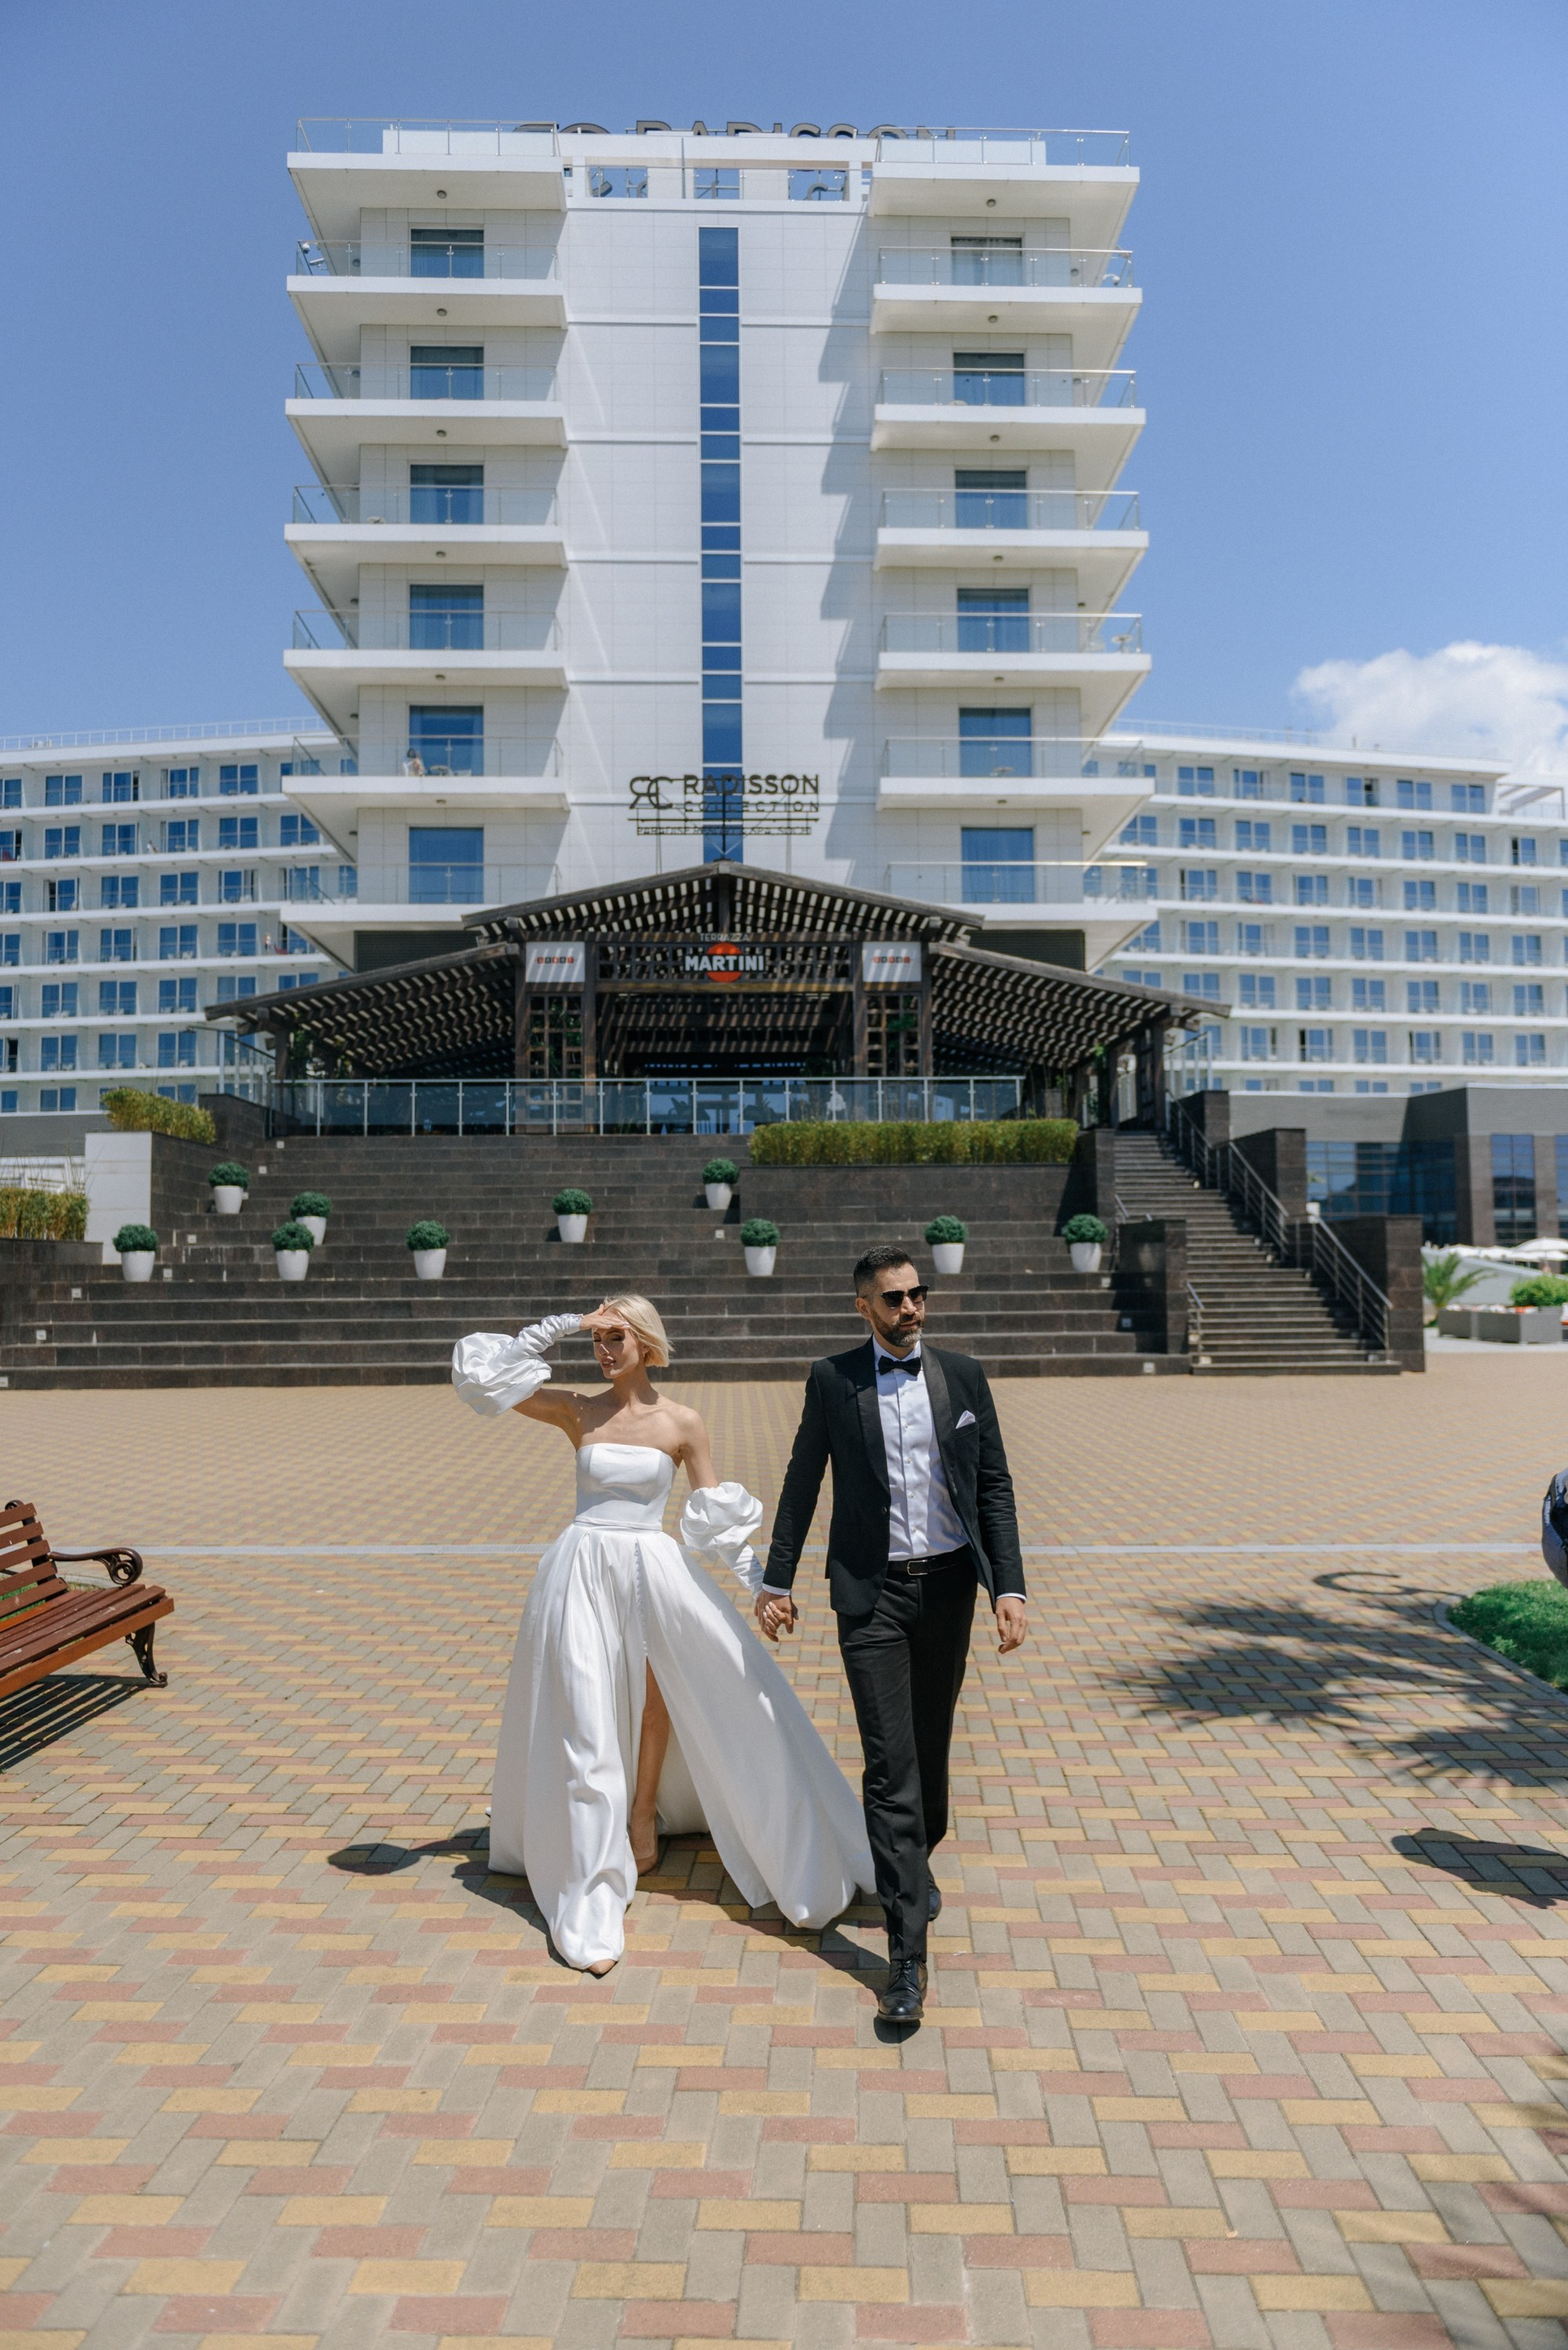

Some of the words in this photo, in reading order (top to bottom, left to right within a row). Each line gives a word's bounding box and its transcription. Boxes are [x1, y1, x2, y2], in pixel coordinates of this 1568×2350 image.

[684, 774, 818, 795] RADISSON
[684, 801, 818, 812] COLLECTION
[699, 933, 750, 942] TERRAZZA
[685, 956, 764, 971] MARTINI
